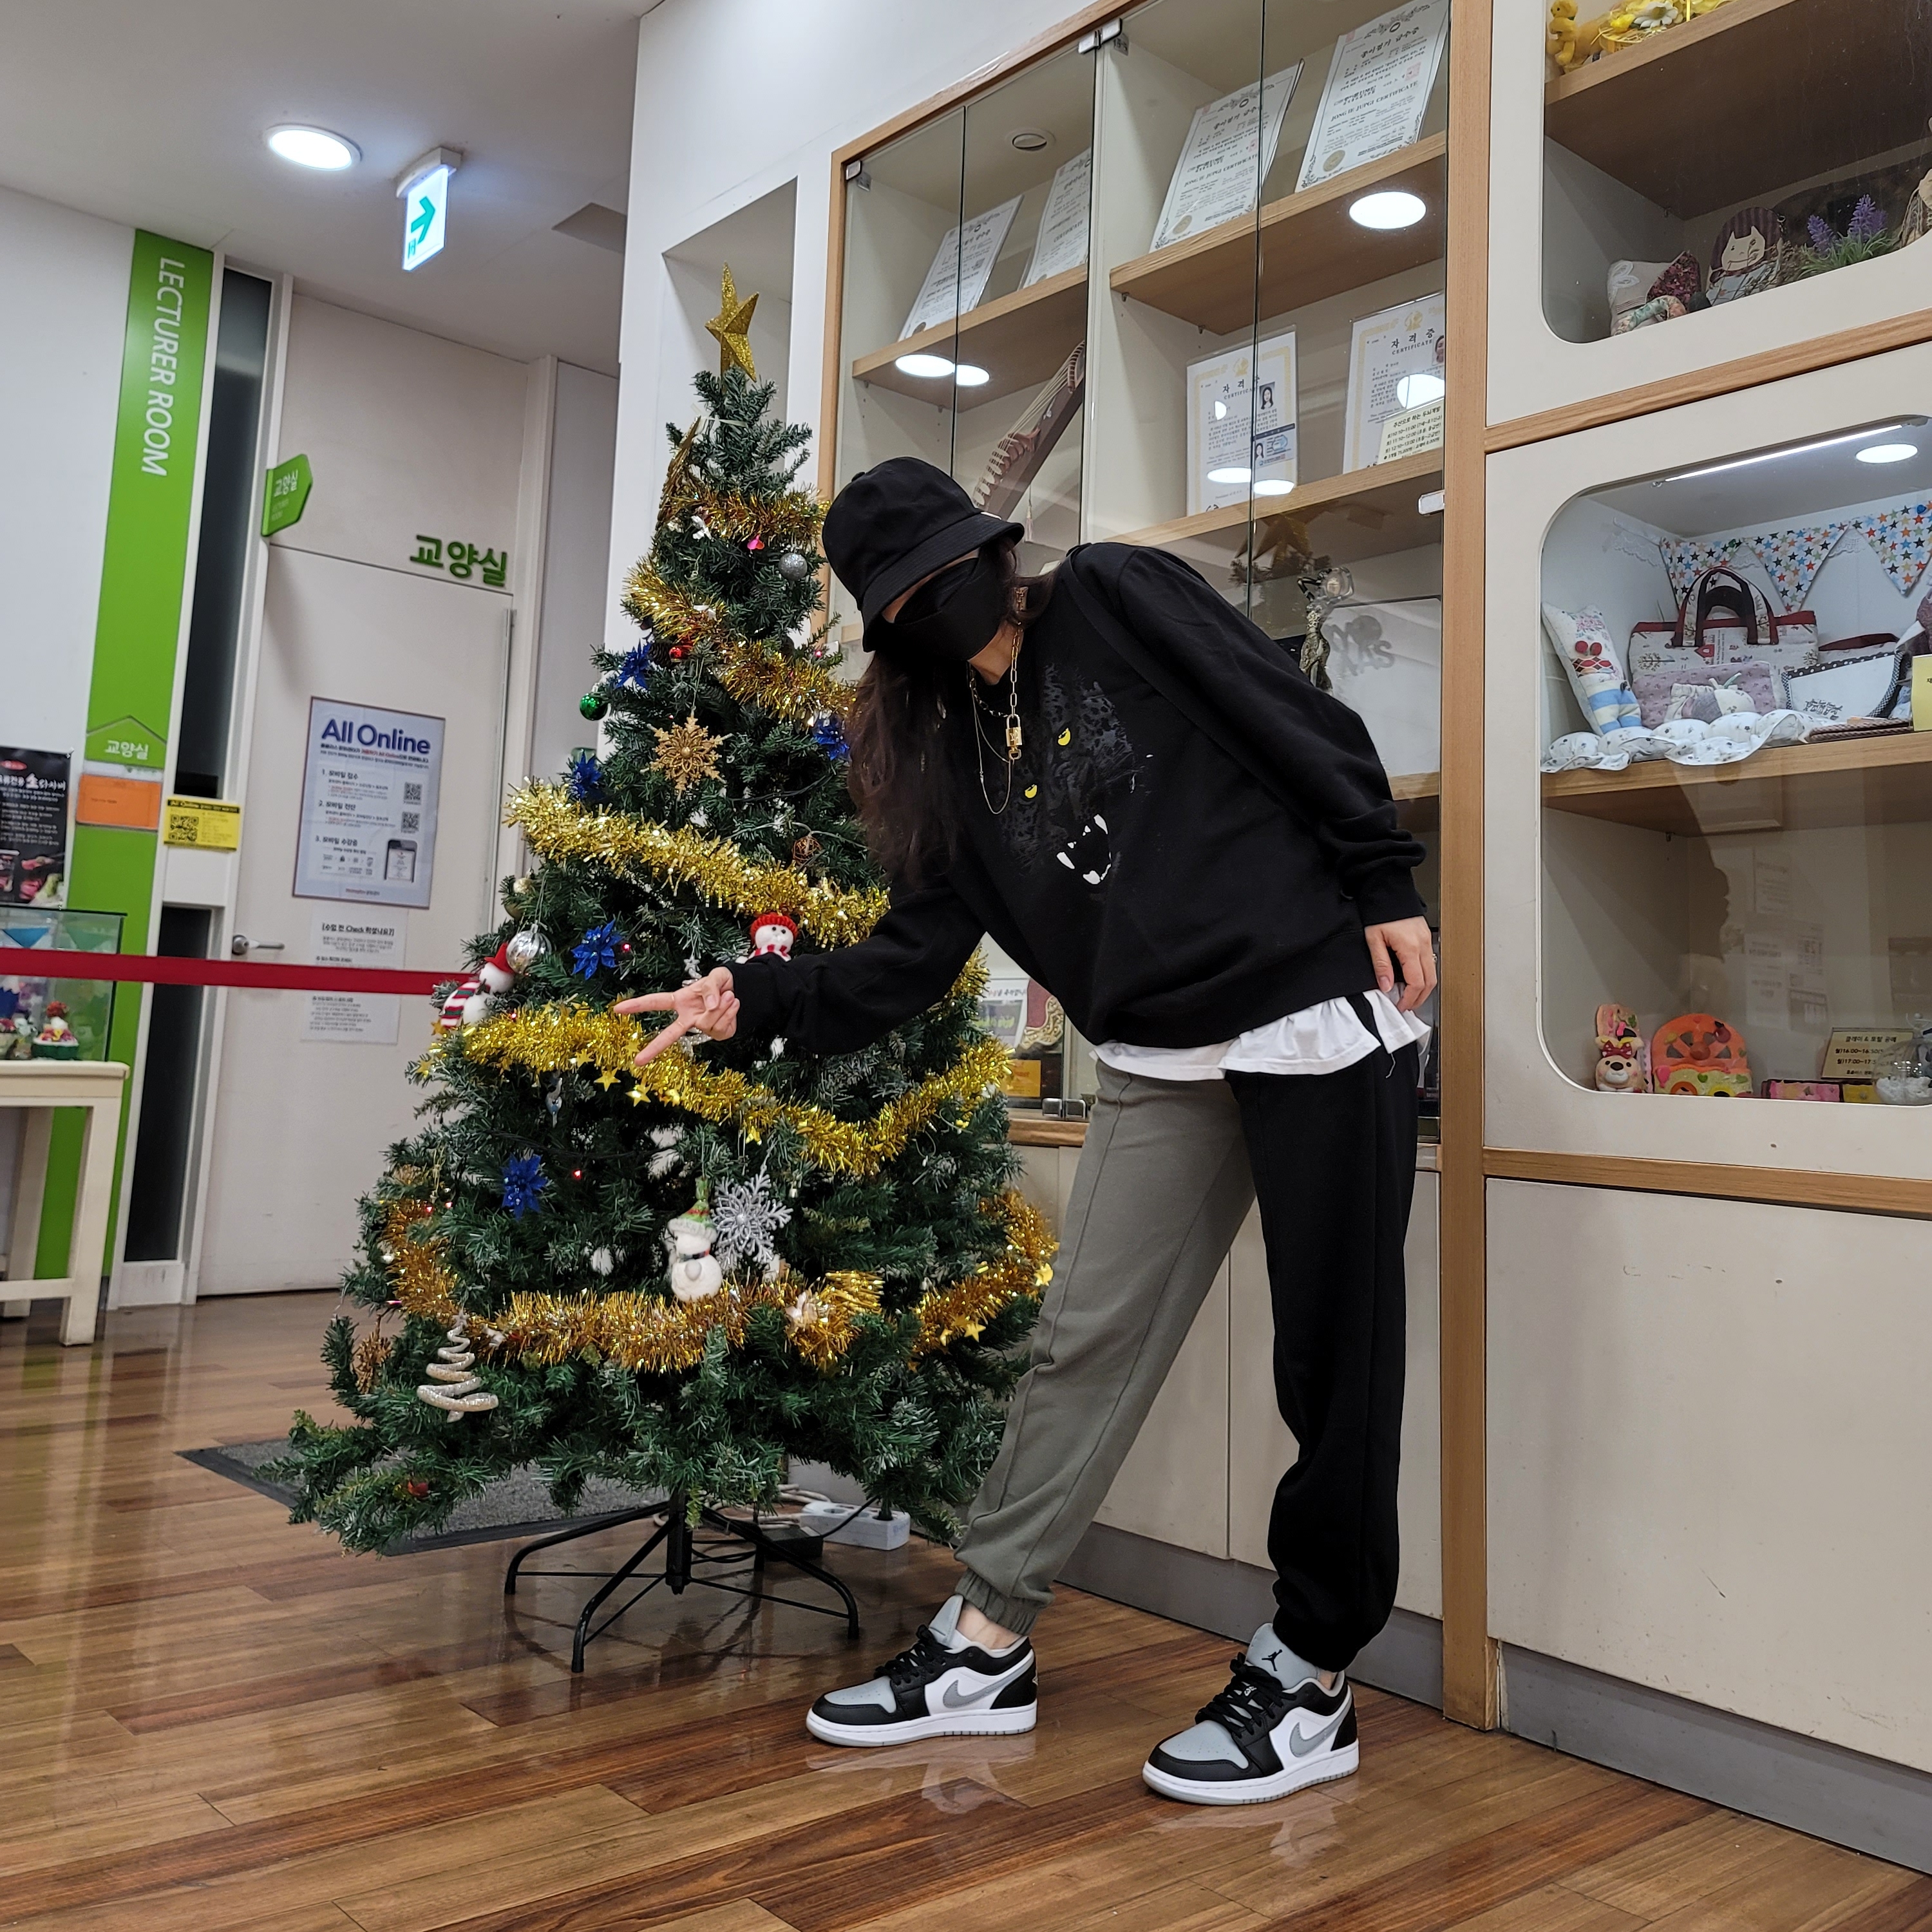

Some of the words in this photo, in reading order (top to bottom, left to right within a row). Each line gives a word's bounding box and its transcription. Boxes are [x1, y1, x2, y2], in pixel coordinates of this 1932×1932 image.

[1376, 80, 1418, 102] CERTIFICATE
[149, 256, 185, 386] LECTURER
[1392, 339, 1432, 355] CERTIFICATE
[141, 389, 174, 477] ROOM
[274, 469, 298, 497] 교양실
[410, 535, 508, 587] 교양실
[321, 718, 354, 744] All
[357, 724, 431, 755] Online
[105, 740, 149, 760] 교양실
[328, 770, 346, 779] 모바일
[325, 801, 343, 810] 모바일
[323, 837, 339, 845] 모바일
[346, 925, 364, 934] Check
